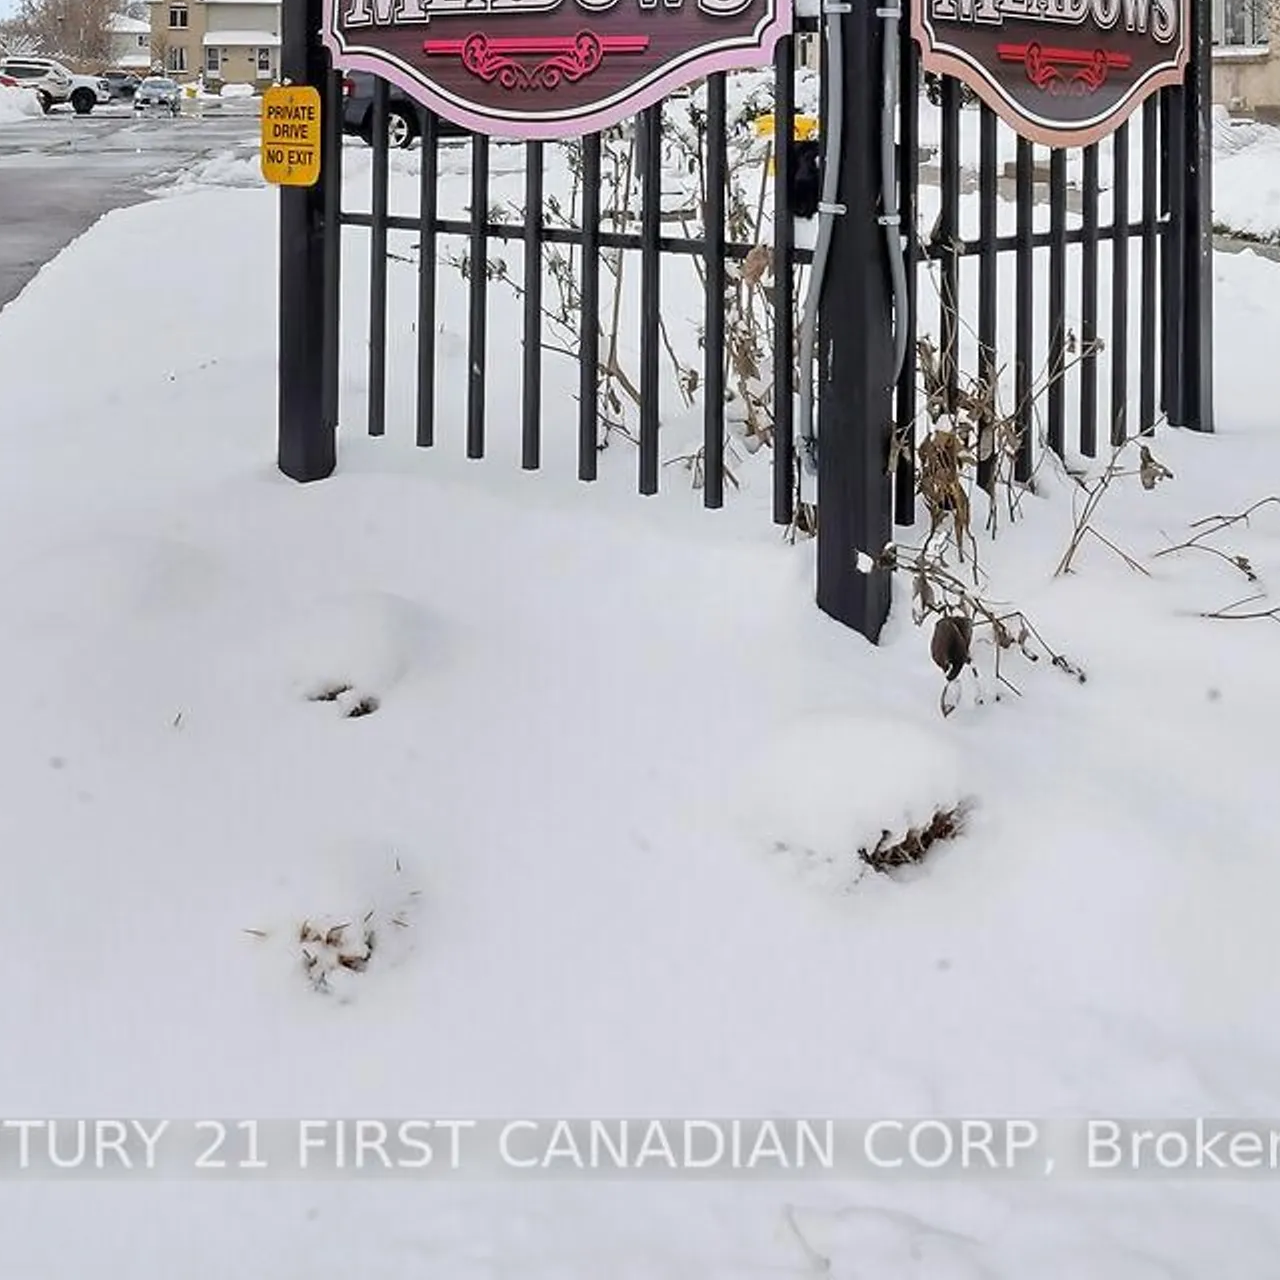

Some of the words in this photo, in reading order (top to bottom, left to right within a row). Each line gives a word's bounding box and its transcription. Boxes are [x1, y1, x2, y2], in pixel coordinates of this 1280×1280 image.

[268, 106, 314, 120] PRIVATE
[274, 124, 308, 139] DRIVE
[266, 149, 284, 164] NO
[288, 150, 314, 165] EXIT
